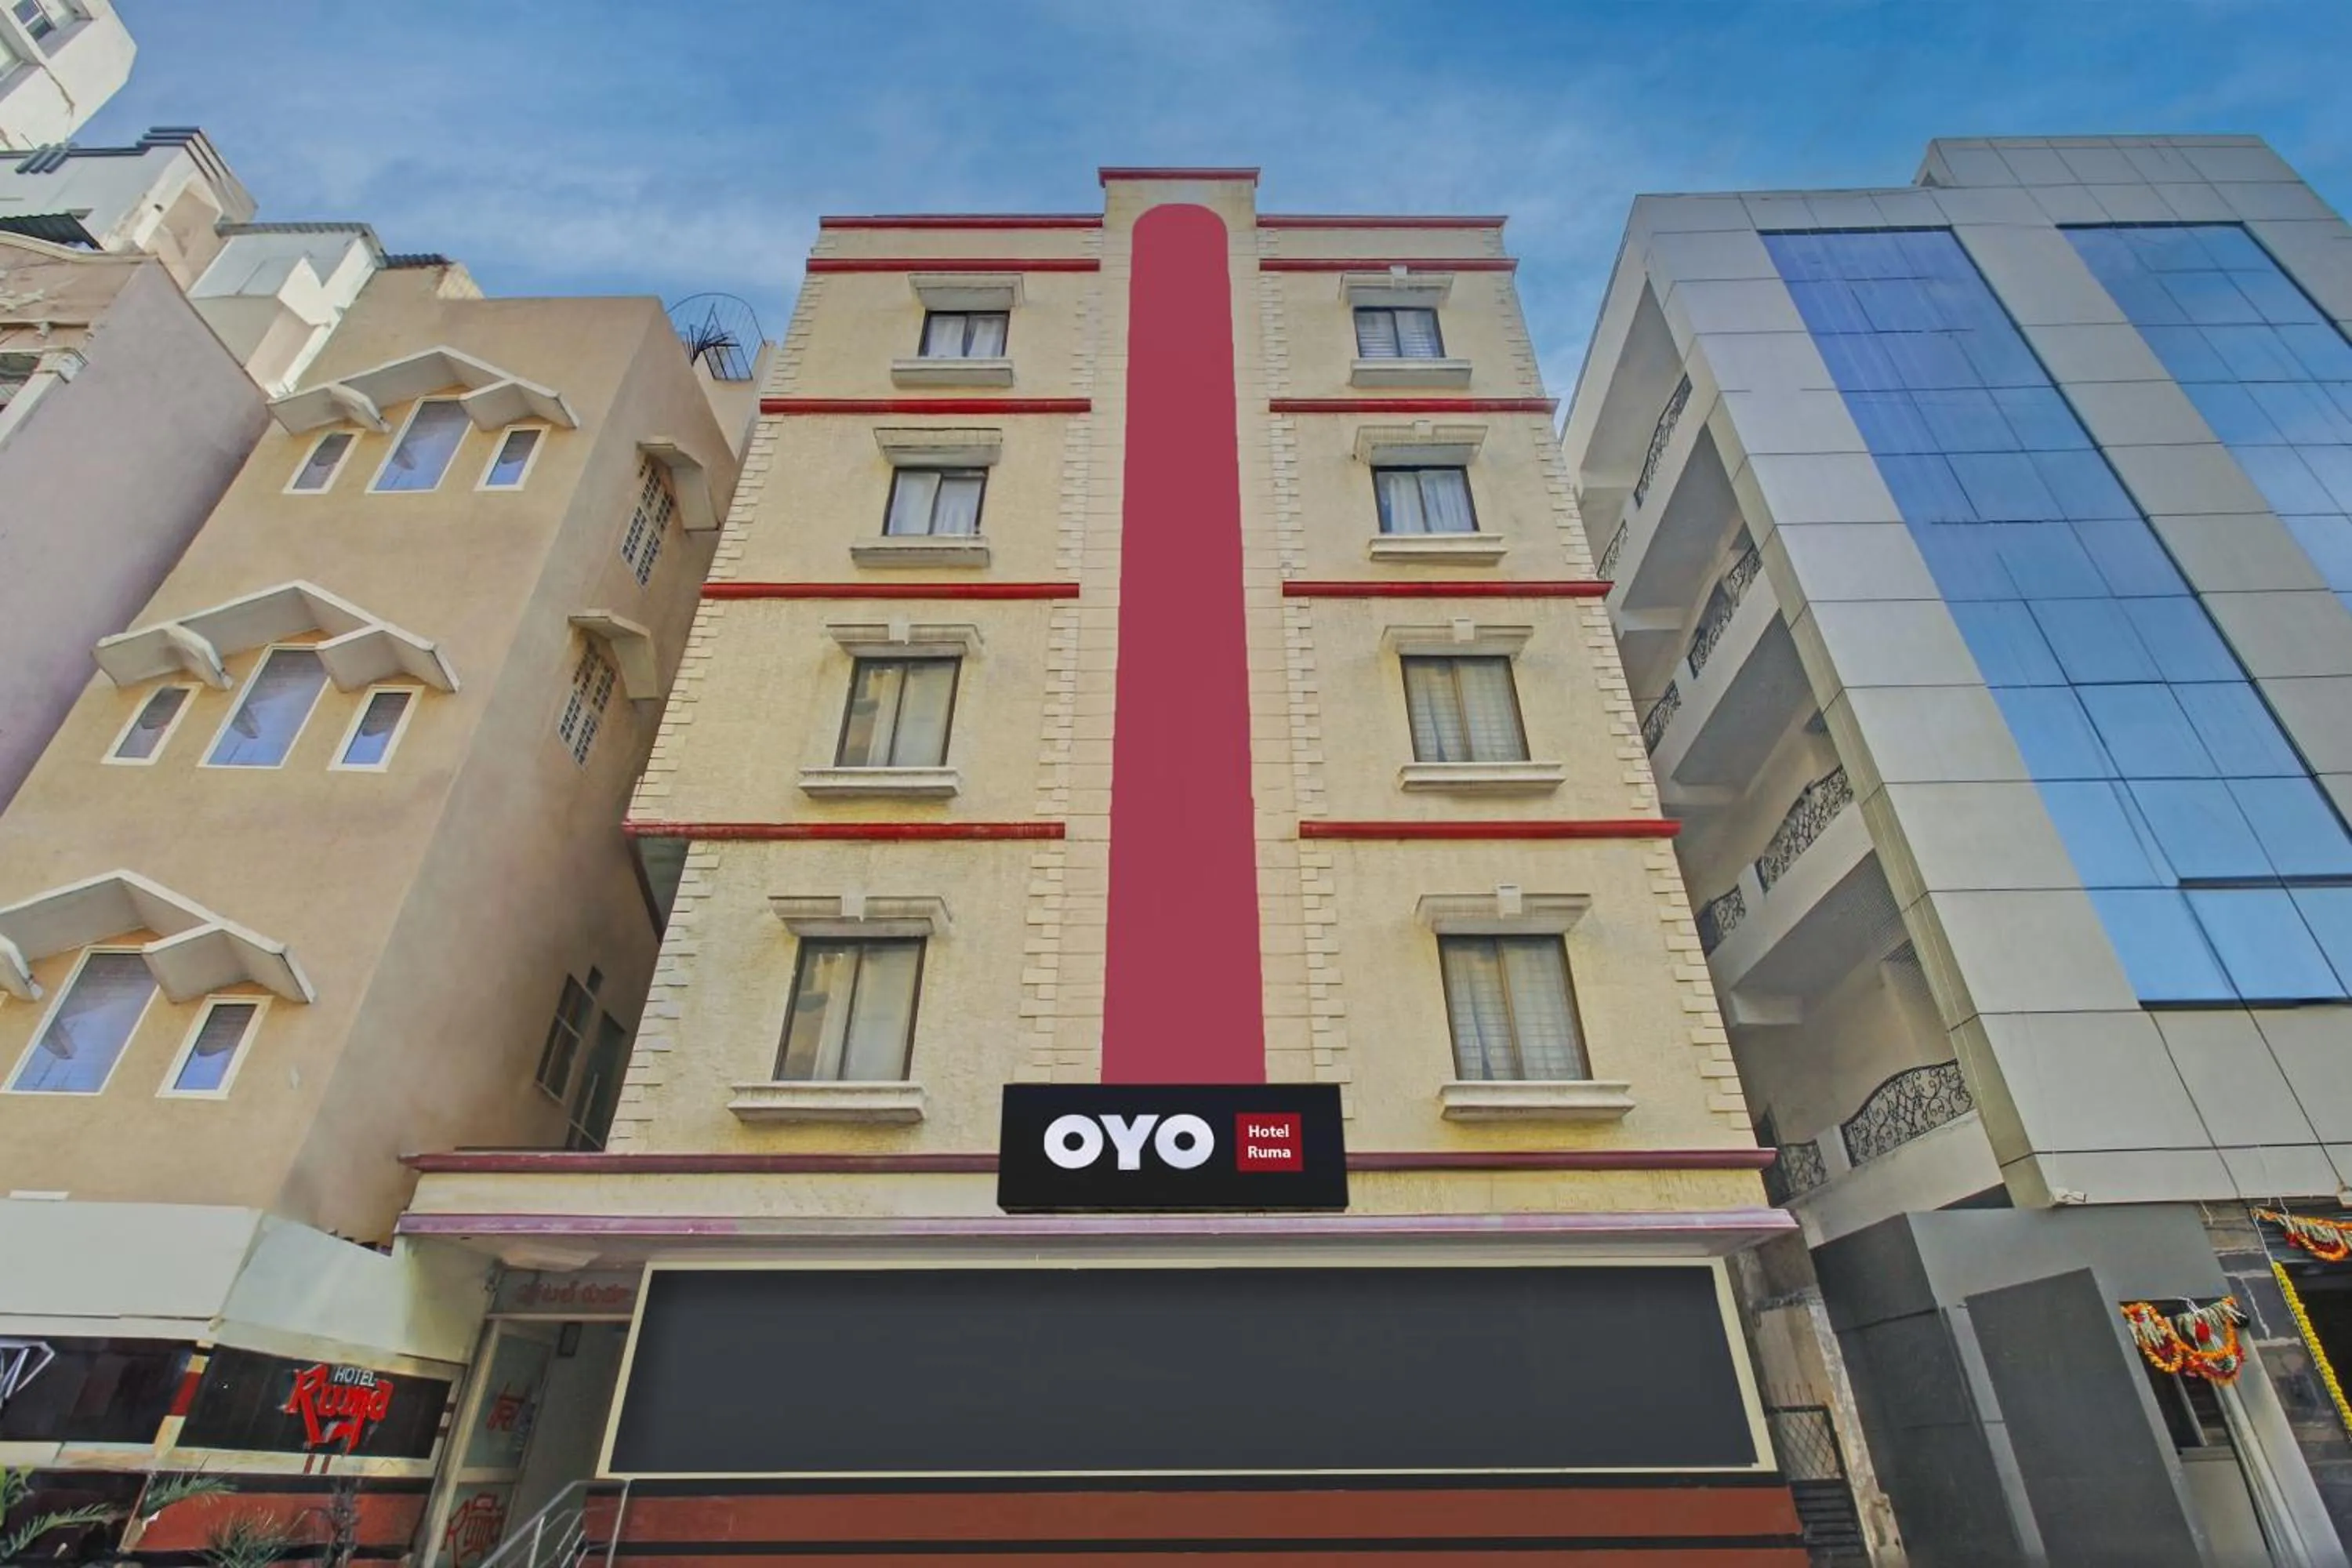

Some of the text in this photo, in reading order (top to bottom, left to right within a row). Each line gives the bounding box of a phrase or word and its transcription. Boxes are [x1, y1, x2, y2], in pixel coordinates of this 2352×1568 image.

[1247, 1124, 1290, 1138] Hotel
[1044, 1114, 1214, 1170] OYO
[1247, 1145, 1291, 1159] Ruma
[334, 1367, 376, 1387] HOTEL
